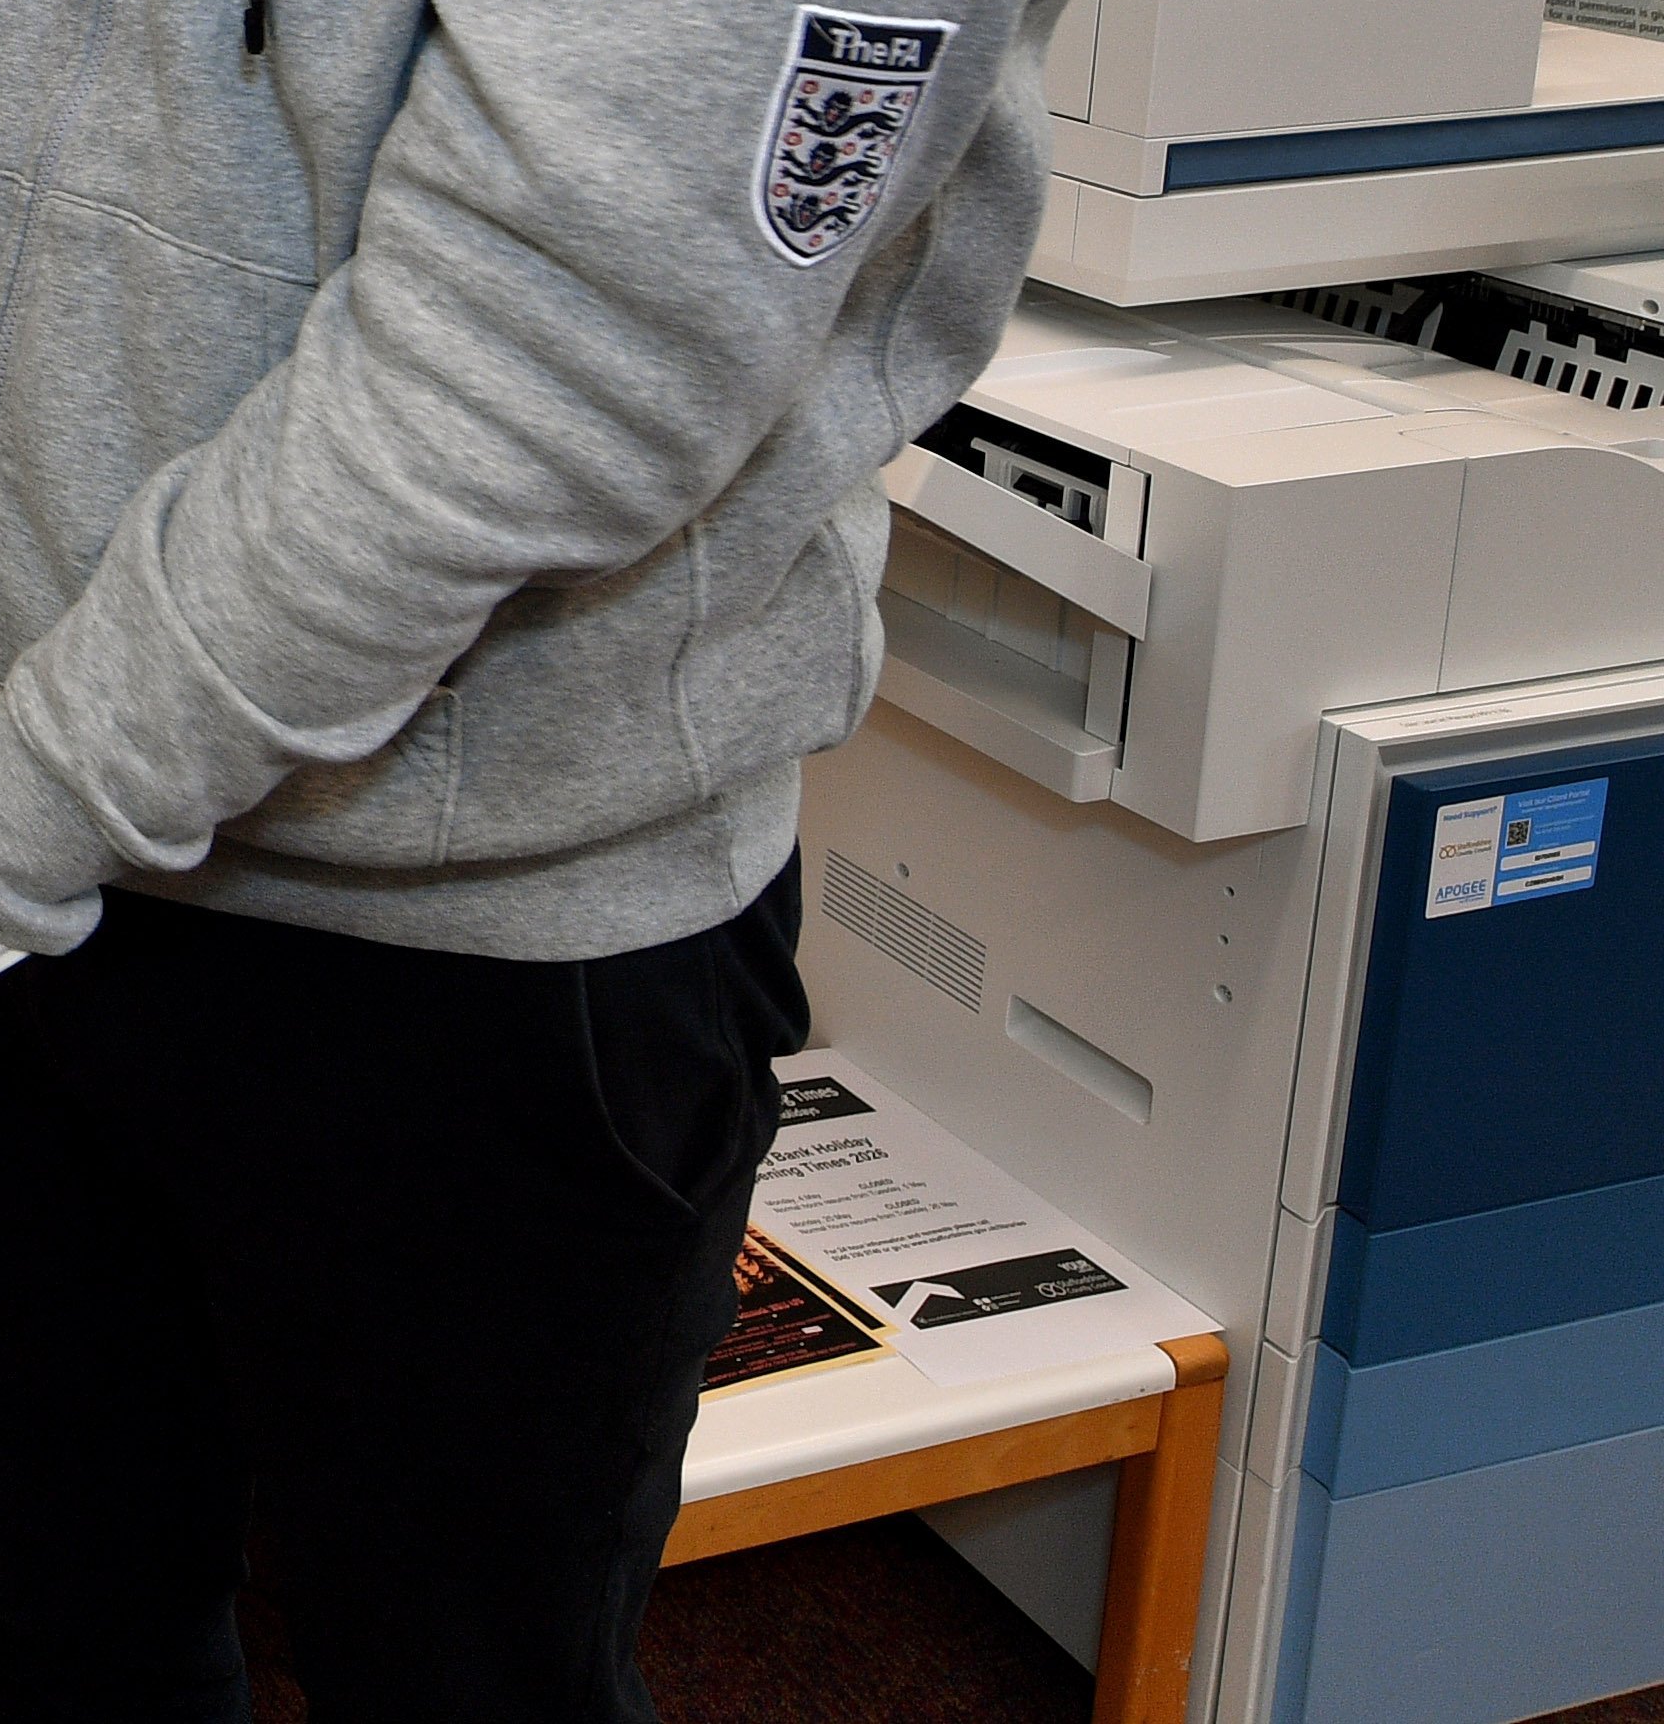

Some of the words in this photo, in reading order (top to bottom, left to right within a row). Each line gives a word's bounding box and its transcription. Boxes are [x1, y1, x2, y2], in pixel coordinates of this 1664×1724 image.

[829, 26, 923, 69] TheFA
[1435, 879, 1486, 899] APOGEE
[794, 1086, 839, 1102] Times
[771, 1147, 814, 1162] Bank
[812, 1137, 873, 1154] Holiday
[799, 1158, 850, 1172] Times
[849, 1148, 889, 1163] 2026
[858, 1178, 893, 1189] CLOSED
[885, 1198, 920, 1210] CLOSED
